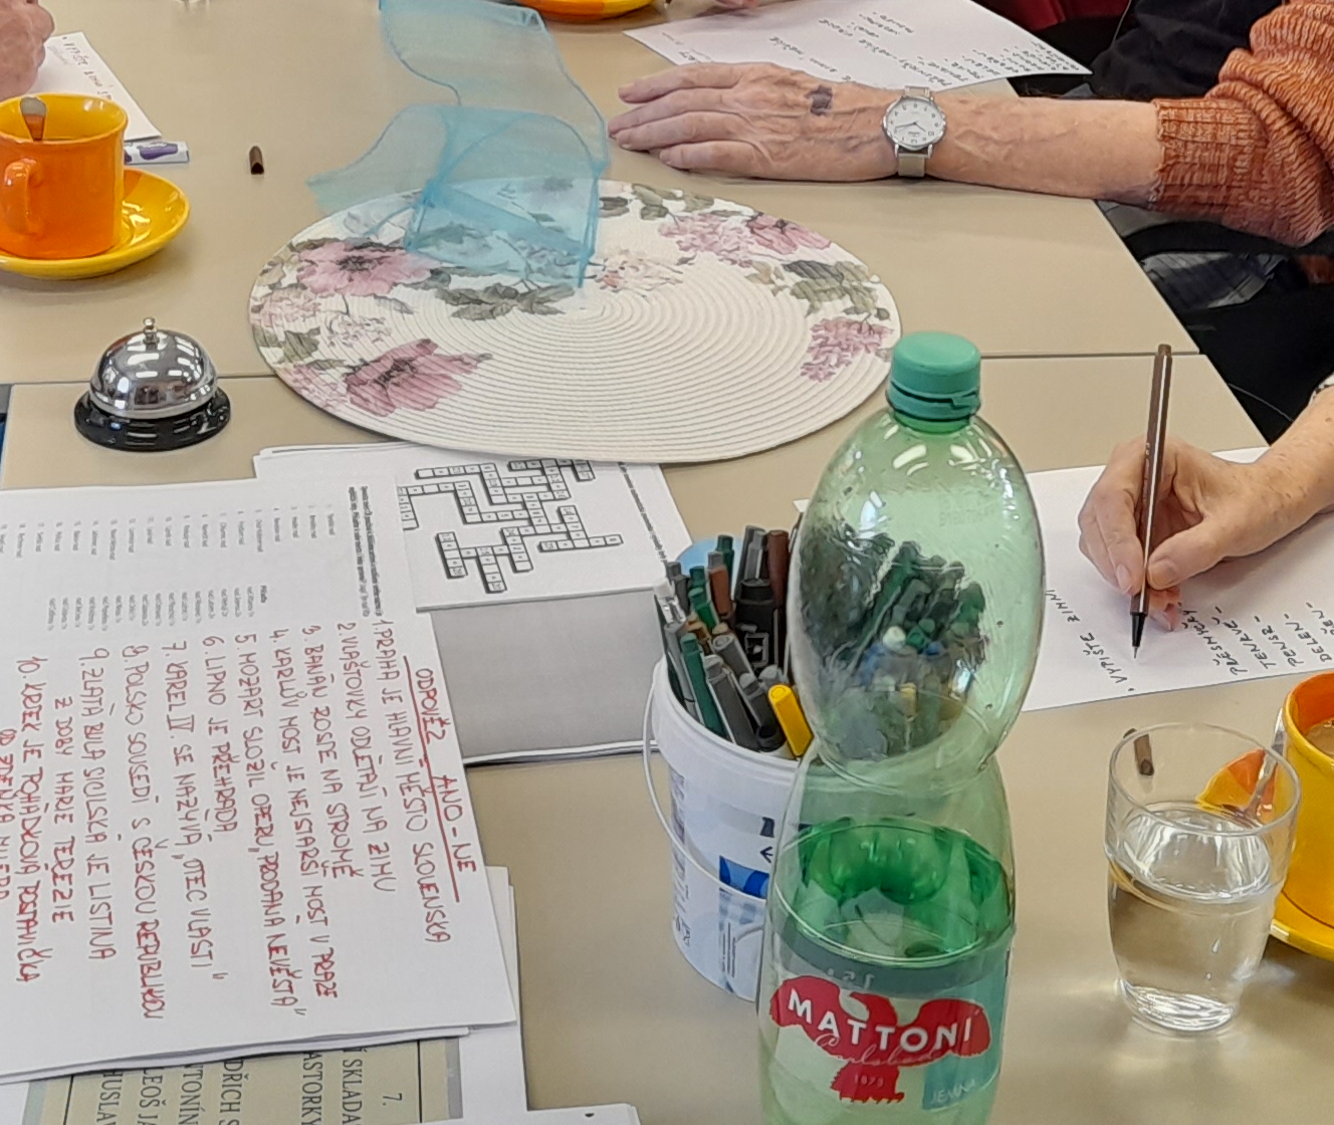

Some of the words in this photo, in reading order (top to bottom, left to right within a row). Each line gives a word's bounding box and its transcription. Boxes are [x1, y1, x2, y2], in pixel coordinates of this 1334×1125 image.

[787, 987, 972, 1052] MATTONI
[341, 1059, 363, 1125] SKLADA
[382, 1092, 403, 1107] 7.
